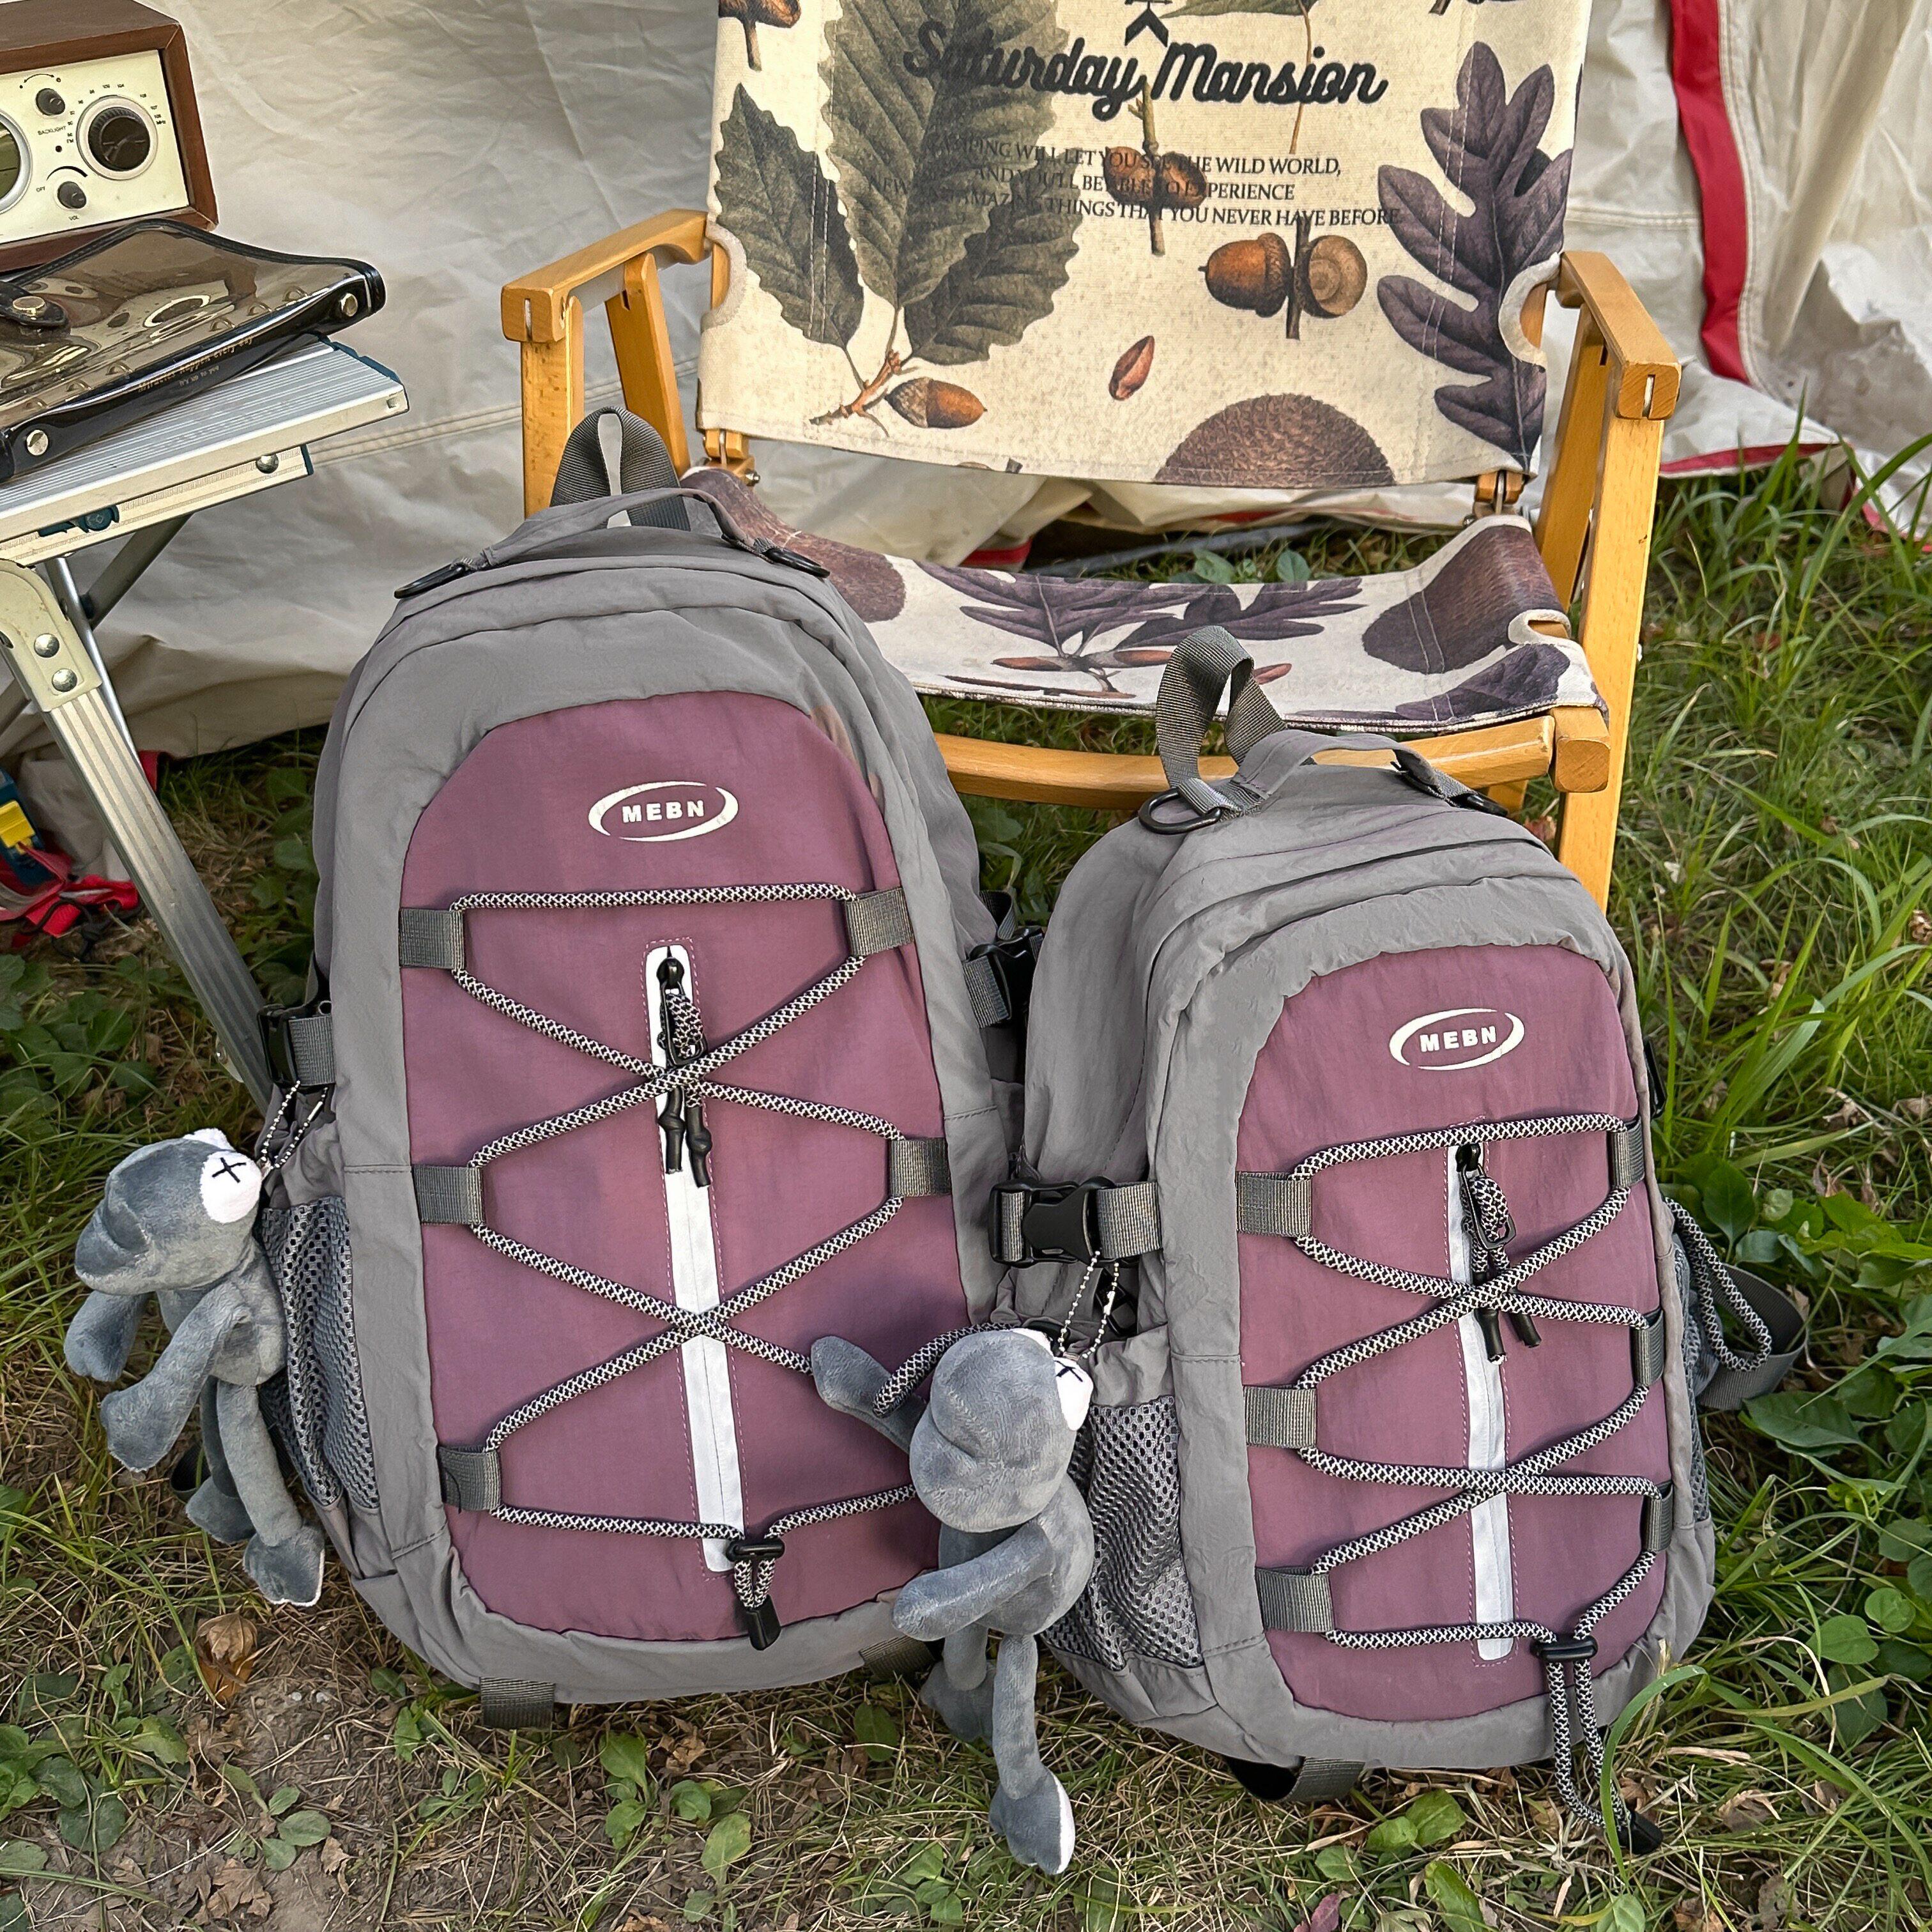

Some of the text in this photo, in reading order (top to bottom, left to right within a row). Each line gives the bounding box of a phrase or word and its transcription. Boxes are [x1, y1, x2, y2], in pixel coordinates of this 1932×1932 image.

[1150, 42, 1389, 104] Mansion
[1015, 141, 1061, 163] WILL
[1063, 148, 1094, 165] LET
[1098, 150, 1137, 169] YOU
[1215, 157, 1264, 175] WILD
[1268, 157, 1340, 181] WORLD,
[976, 165, 1012, 183] AND
[1082, 174, 1105, 192] BE
[1107, 176, 1150, 196] BLE
[1183, 180, 1294, 201] EPERIENCE
[1046, 195, 1116, 218] THINGS
[1166, 204, 1208, 224] YOU
[1212, 206, 1271, 226] NEVER
[1273, 208, 1325, 227] HAVE
[622, 800, 704, 824] MEBN
[1420, 1025, 1497, 1053] MEBN
